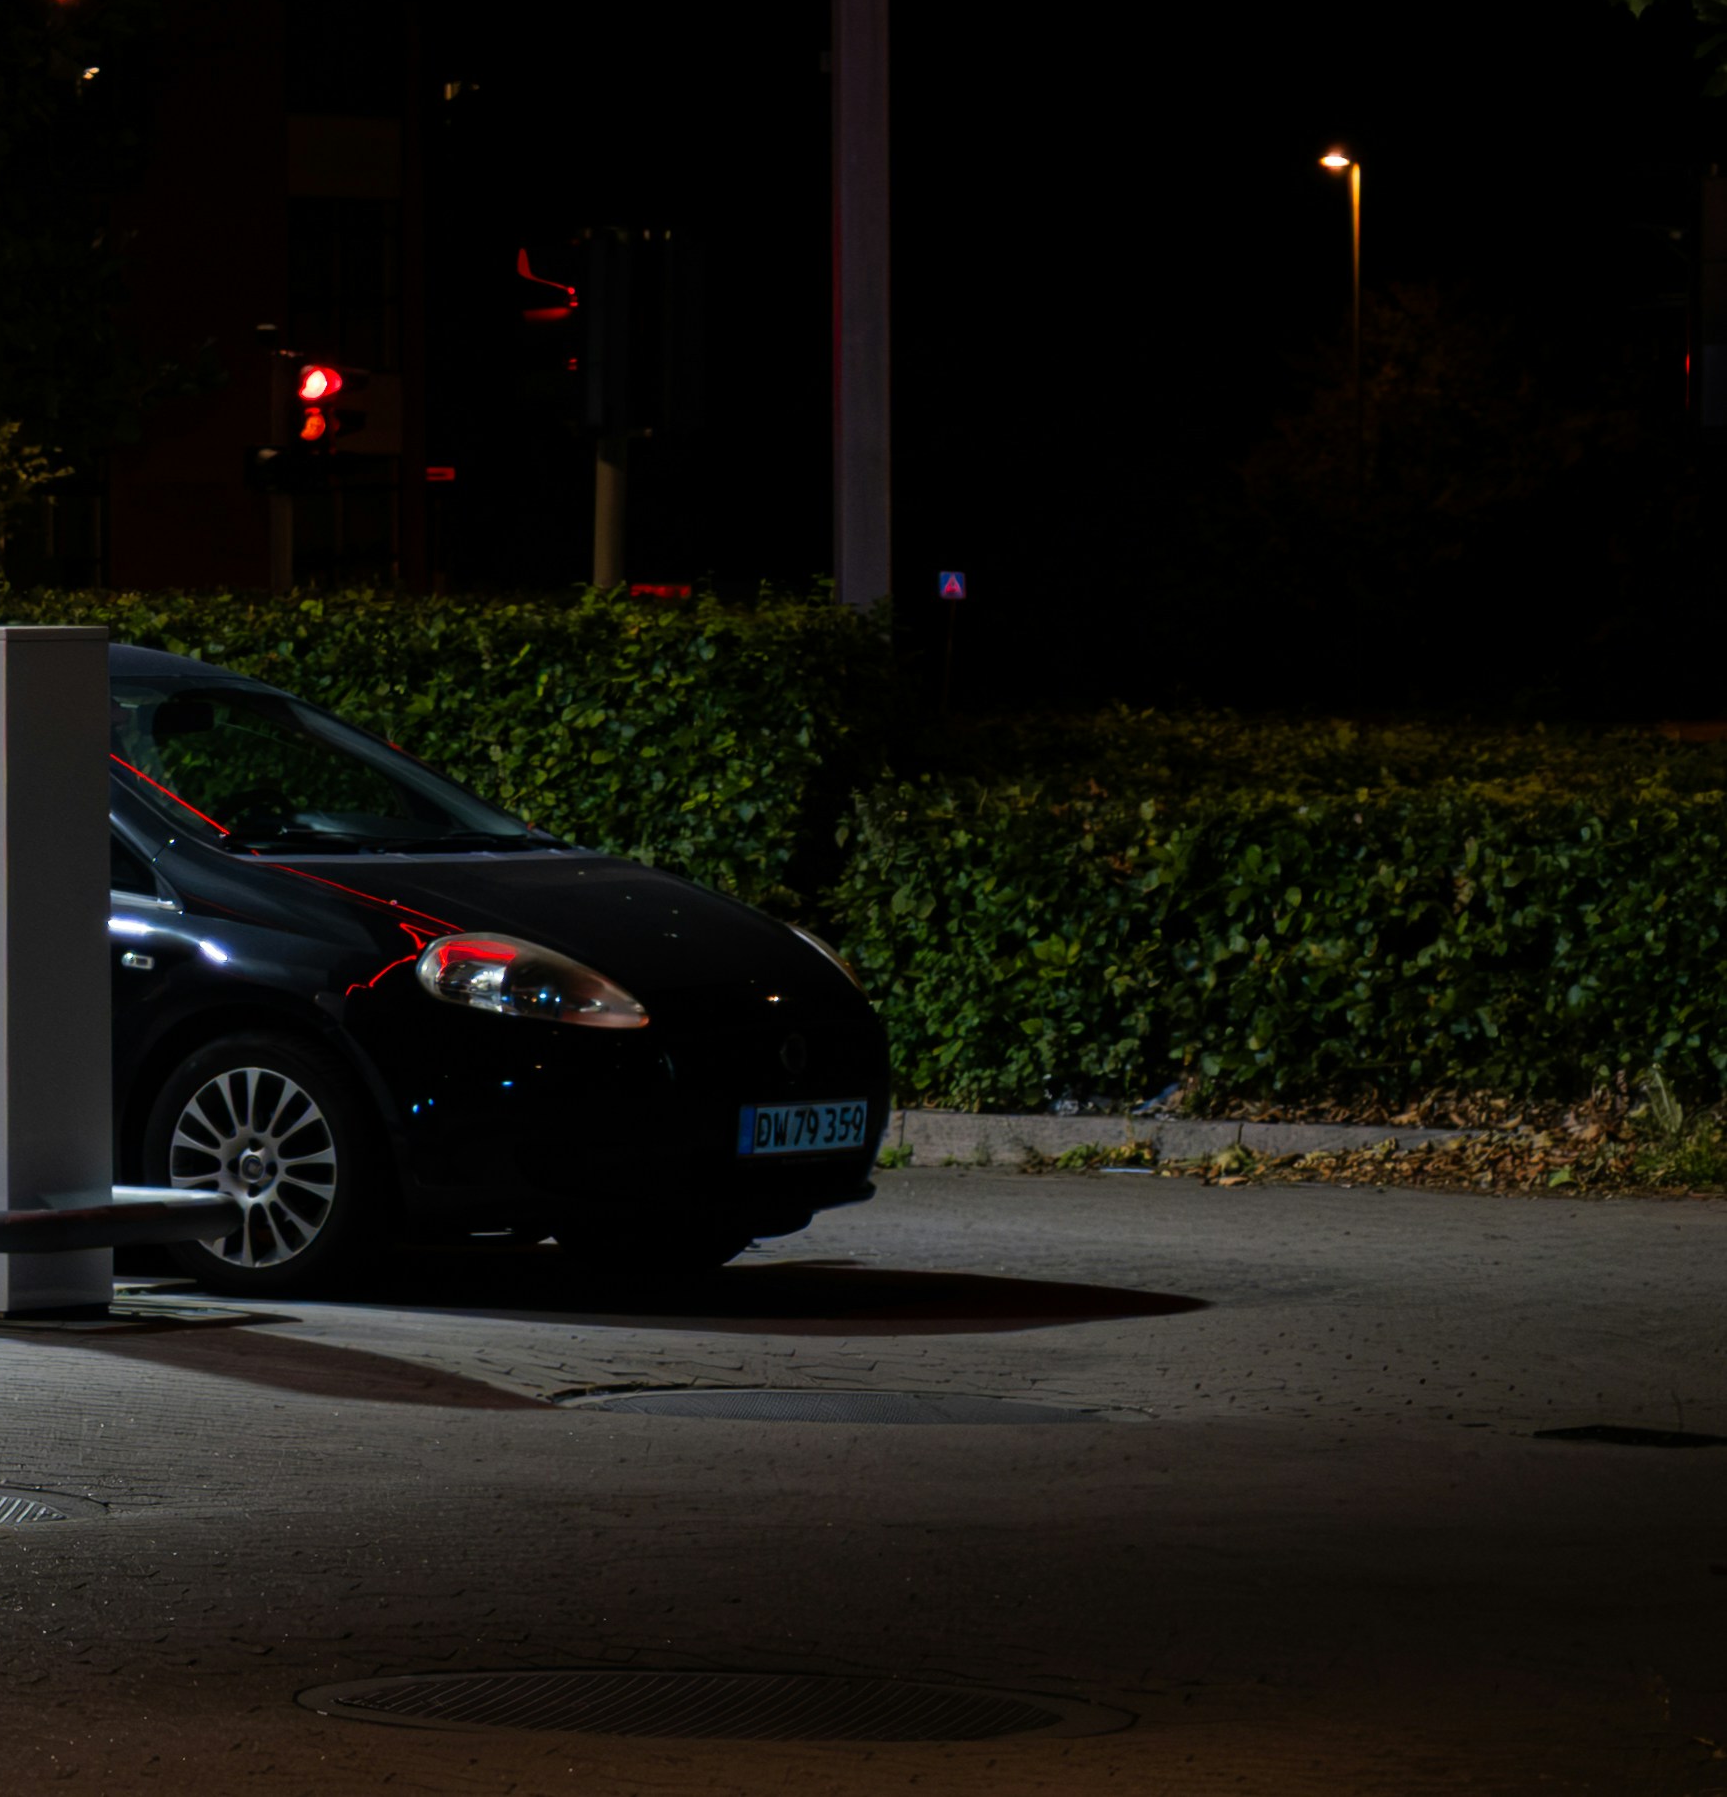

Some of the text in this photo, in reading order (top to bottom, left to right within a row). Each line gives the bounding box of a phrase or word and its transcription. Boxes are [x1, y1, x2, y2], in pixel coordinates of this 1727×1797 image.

[756, 1105, 864, 1147] DW 79 359
